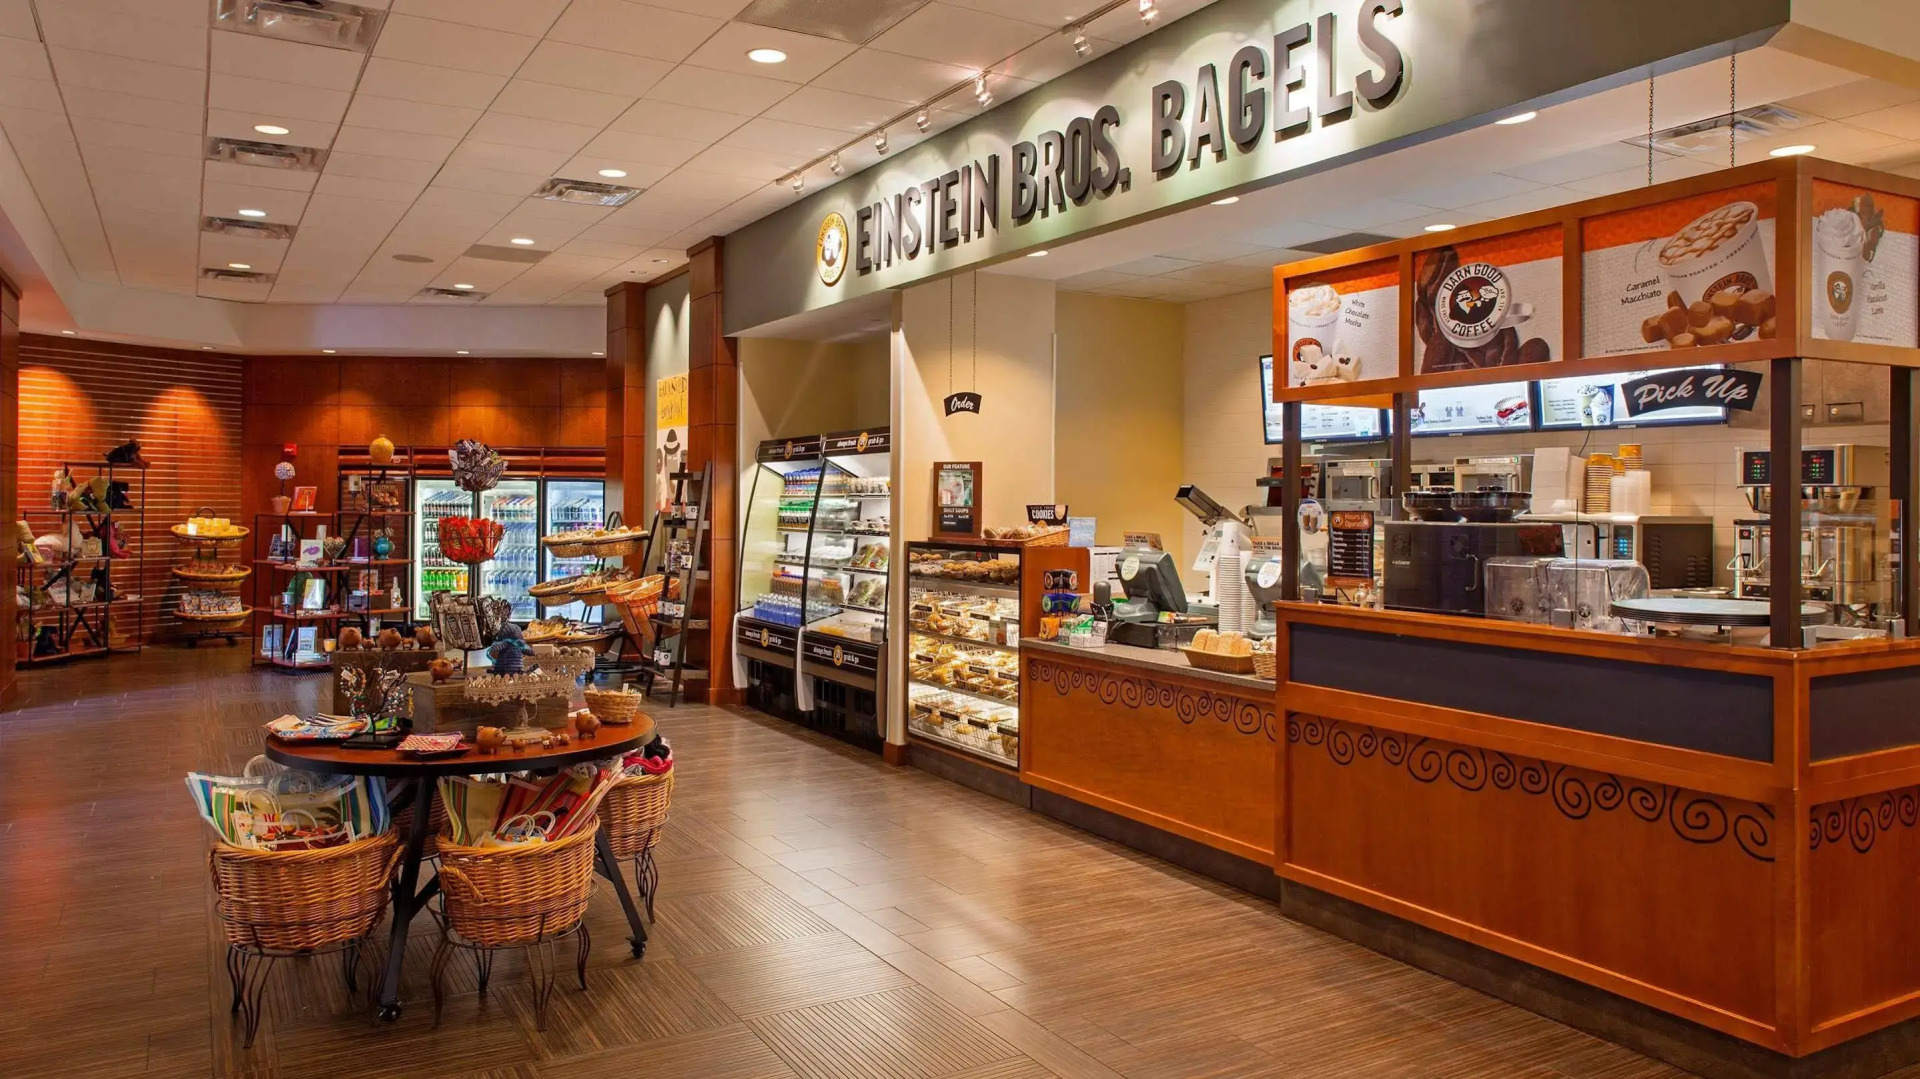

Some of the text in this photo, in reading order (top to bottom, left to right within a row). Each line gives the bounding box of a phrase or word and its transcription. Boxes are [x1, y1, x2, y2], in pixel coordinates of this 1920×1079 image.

[855, 0, 1405, 275] EINSTEIN BROS. BAGELS
[1443, 263, 1503, 293] DARN GOOD
[1626, 275, 1661, 293] Caramel
[1351, 298, 1366, 309] White
[1620, 289, 1662, 306] Macchiato
[1344, 307, 1370, 320] Chocolate
[1344, 317, 1362, 328] Mocha
[1451, 317, 1496, 338] COFFEE
[1633, 374, 1750, 411] Pick Up
[950, 395, 974, 413] Order
[1031, 509, 1055, 520] COOKIES
